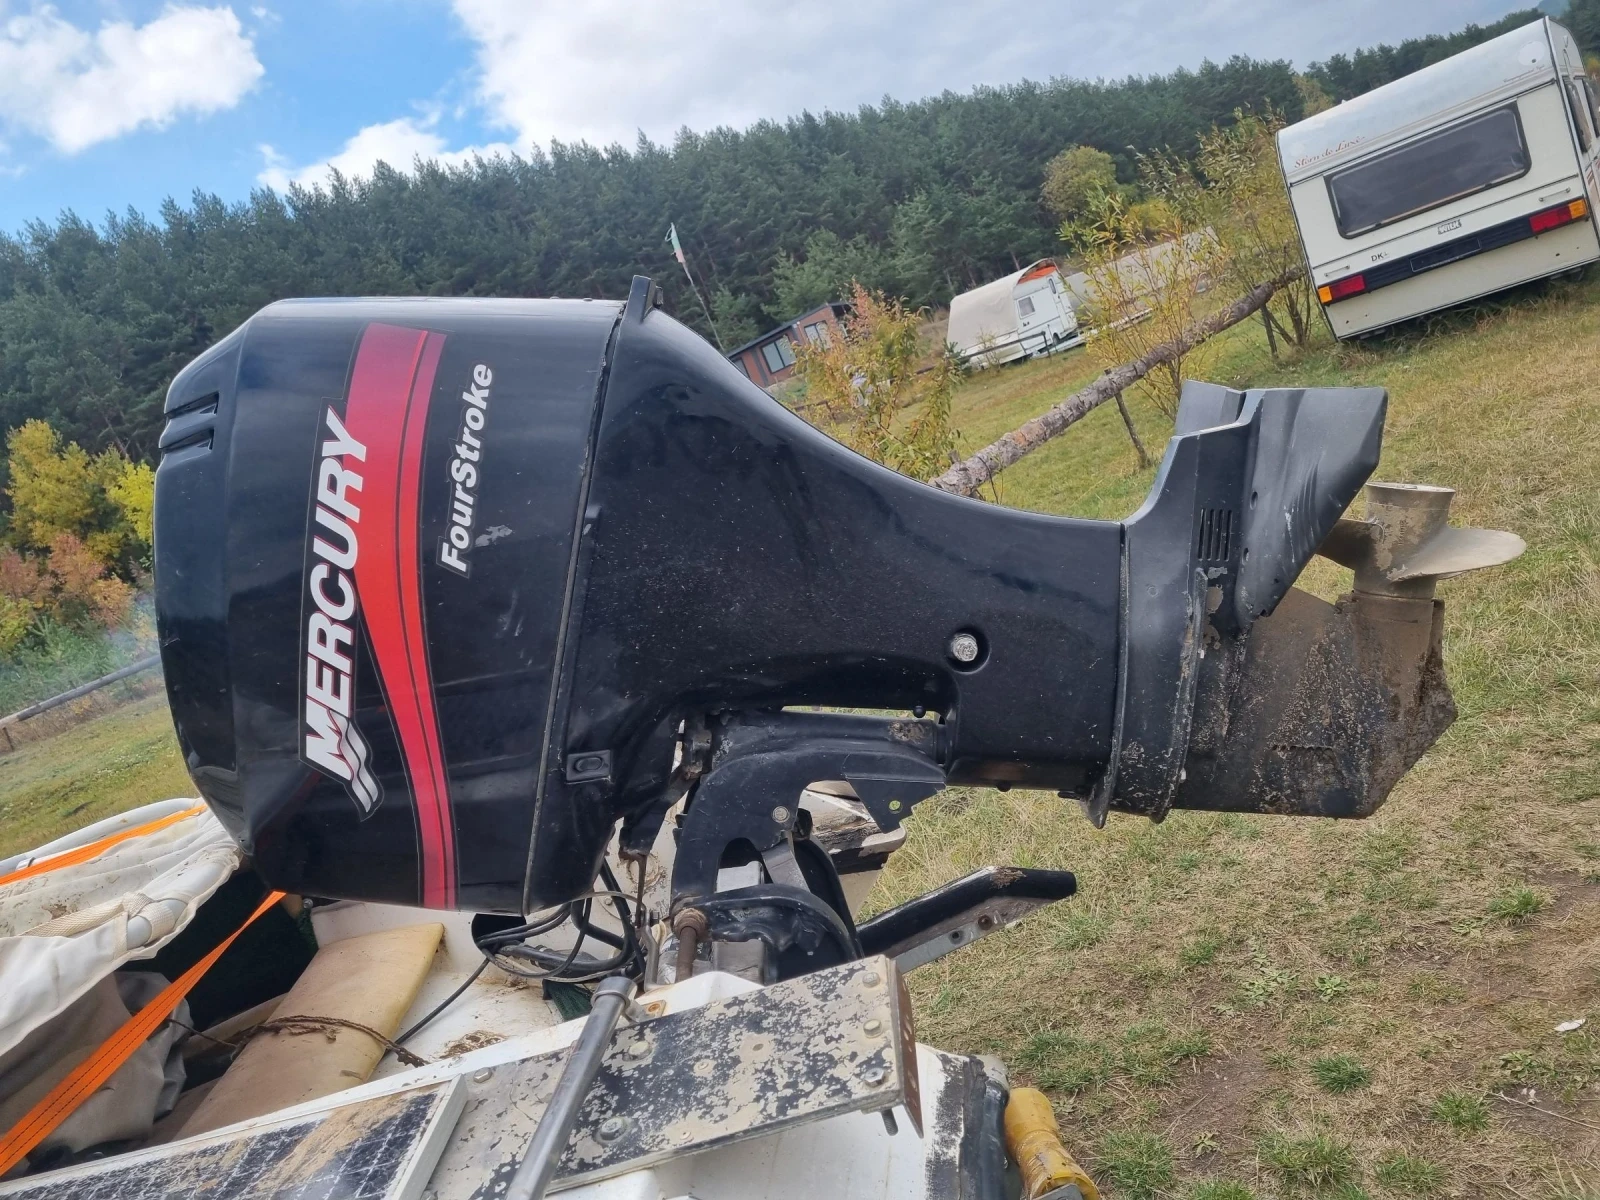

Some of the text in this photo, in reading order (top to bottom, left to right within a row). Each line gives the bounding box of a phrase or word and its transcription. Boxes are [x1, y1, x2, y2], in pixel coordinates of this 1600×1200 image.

[1371, 252, 1384, 262] DK
[441, 364, 493, 573] FourStroke
[305, 404, 367, 782] MERCURY
